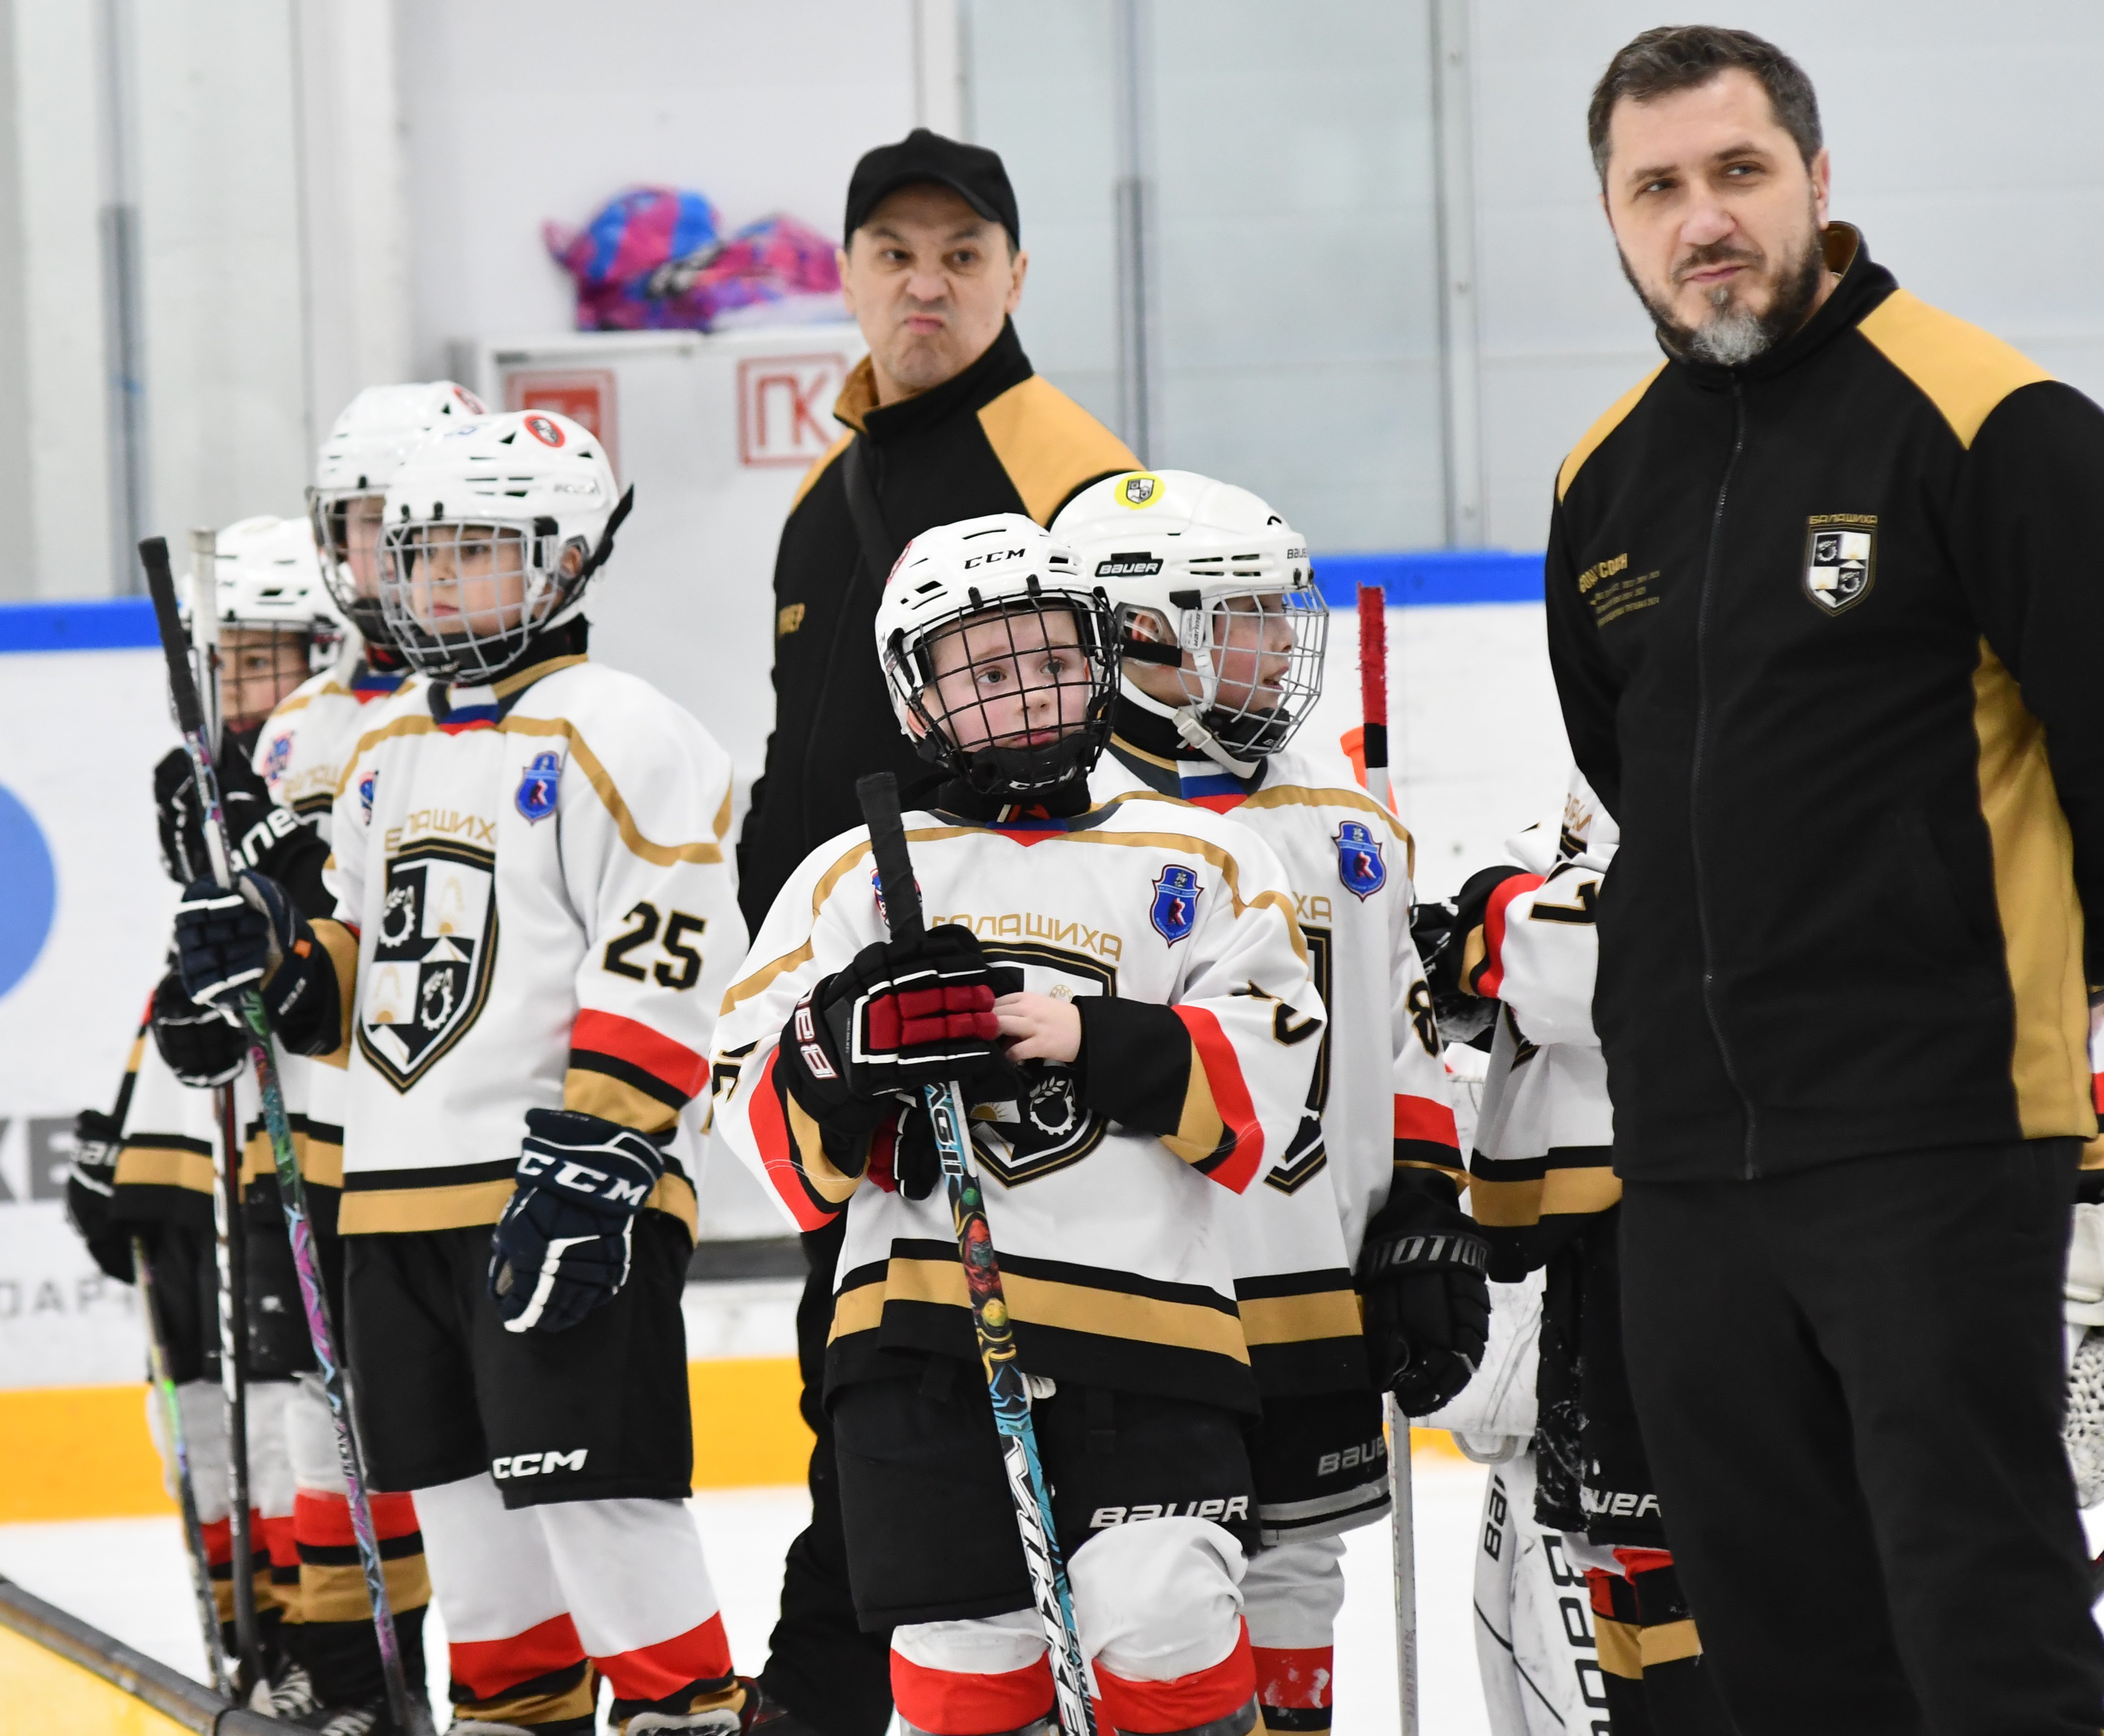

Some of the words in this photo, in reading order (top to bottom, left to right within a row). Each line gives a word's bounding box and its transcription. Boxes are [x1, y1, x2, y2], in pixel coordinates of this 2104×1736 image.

[964, 548, 1025, 569] CCM
[1099, 563, 1158, 574] BAUER
[602, 899, 708, 992] 25
[516, 1149, 649, 1205] CCM
[492, 1449, 589, 1479] CCM
[1090, 1495, 1249, 1529] BAUER
[1003, 1435, 1093, 1736] VIKKE
